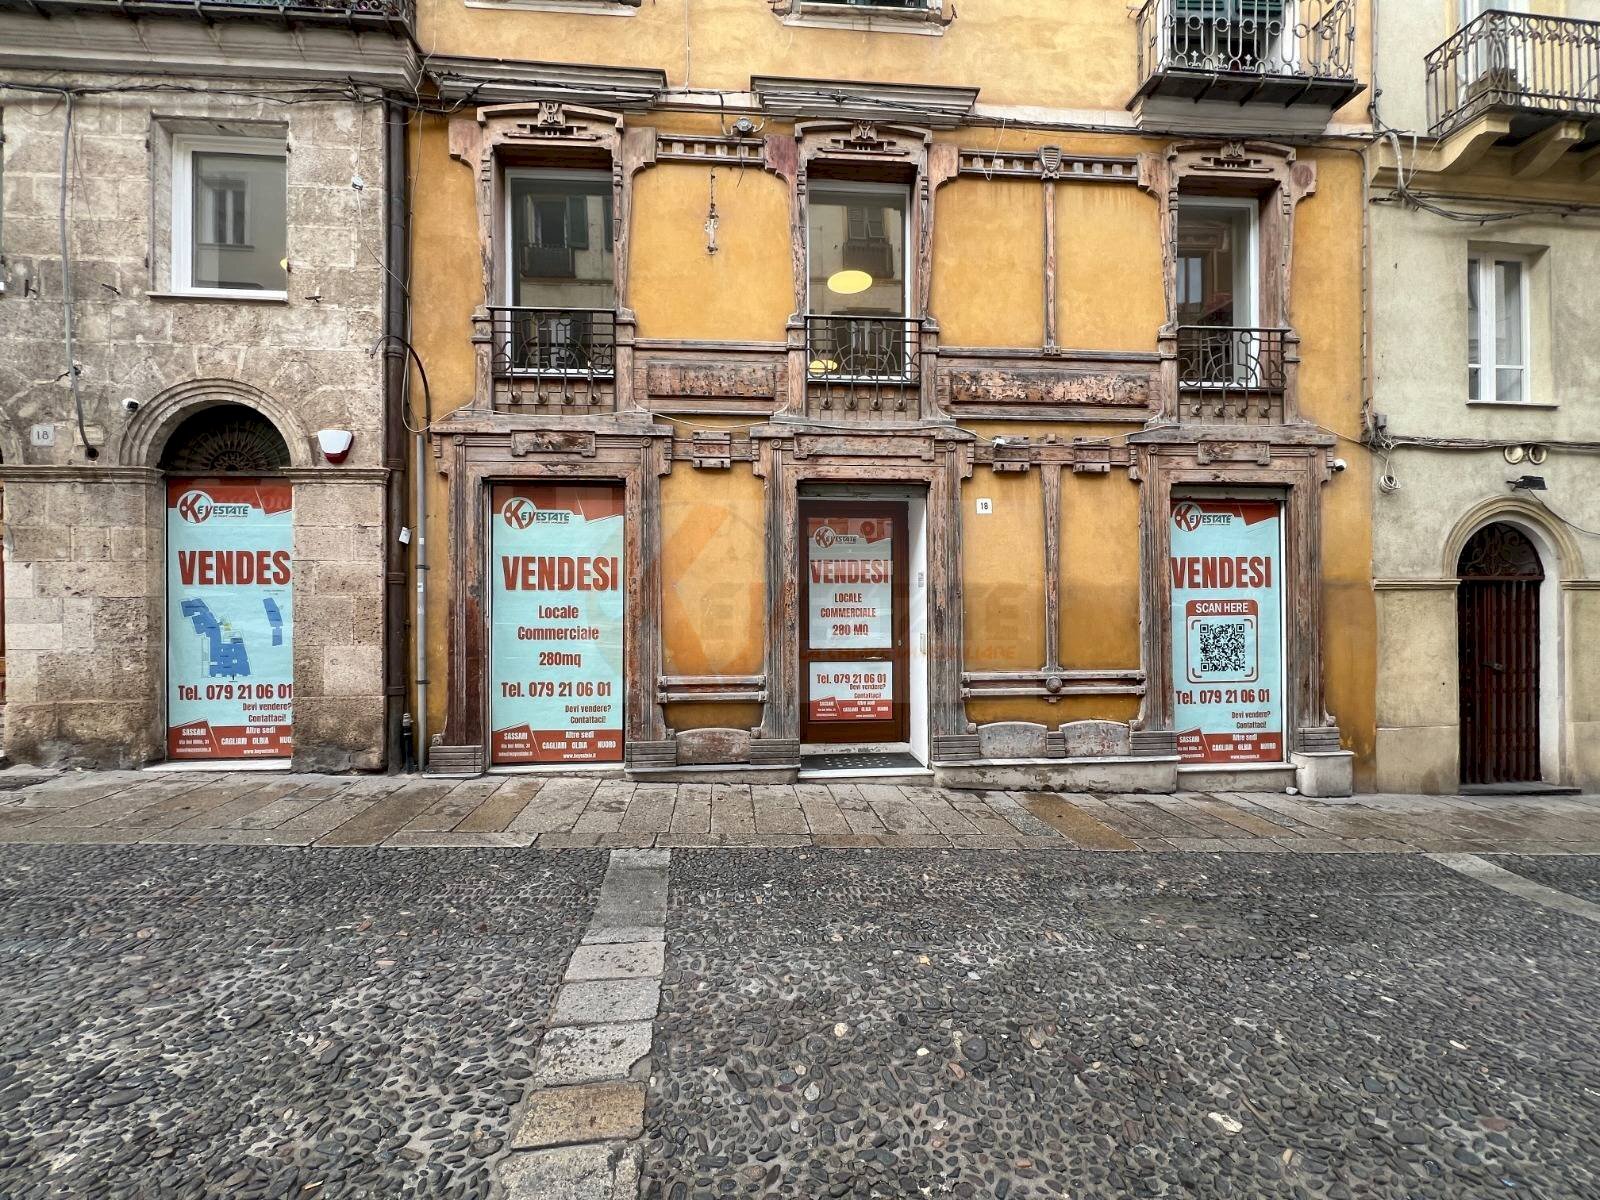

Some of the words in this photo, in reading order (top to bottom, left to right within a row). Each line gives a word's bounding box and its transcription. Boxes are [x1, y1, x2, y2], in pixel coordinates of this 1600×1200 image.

[37, 430, 49, 440] 18
[980, 502, 988, 510] 18
[502, 556, 618, 591] VENDESI
[810, 559, 889, 584] VENDESI
[1171, 556, 1272, 588] VENDESI
[834, 592, 862, 602] LOCALE
[538, 605, 579, 619] Locale
[1196, 602, 1221, 613] SCAN
[1224, 602, 1248, 612] HERE
[820, 608, 876, 618] COMMERCIALE
[518, 626, 600, 640] Commerciale
[832, 624, 851, 636] 280
[854, 624, 869, 636] MQ
[538, 652, 582, 668] 280mq
[816, 674, 832, 684] Tel.
[834, 674, 850, 684] 079
[852, 674, 862, 684] 21
[864, 674, 875, 684] 06
[877, 674, 887, 684] 01
[178, 684, 202, 700] Tel.
[206, 684, 234, 700] 079
[238, 684, 252, 700] 21
[256, 684, 274, 700] 06
[278, 684, 292, 699] 01
[502, 682, 525, 698] Tel.
[528, 682, 554, 698] 079
[558, 682, 573, 697] 21
[576, 682, 594, 696] 06
[598, 682, 612, 696] 01
[1176, 690, 1197, 704] Tel.
[1200, 690, 1222, 704] 079
[1226, 690, 1238, 704] 21
[1240, 689, 1256, 703] 06
[1258, 688, 1270, 702] 01
[242, 702, 258, 711] Devi
[260, 702, 292, 711] vendere?
[564, 704, 580, 713] Devi
[580, 704, 612, 713] vendere?
[248, 714, 286, 722] Contattaci!
[570, 716, 606, 724] Contattaci!
[182, 728, 206, 736] SASSARI
[246, 726, 260, 734] Altre
[262, 726, 276, 734] sedi
[566, 731, 580, 739] Altre
[580, 730, 594, 738] sedi
[504, 732, 528, 740] SASSARI
[542, 742, 567, 750] CAGLIARI
[572, 742, 588, 750] OLBIA
